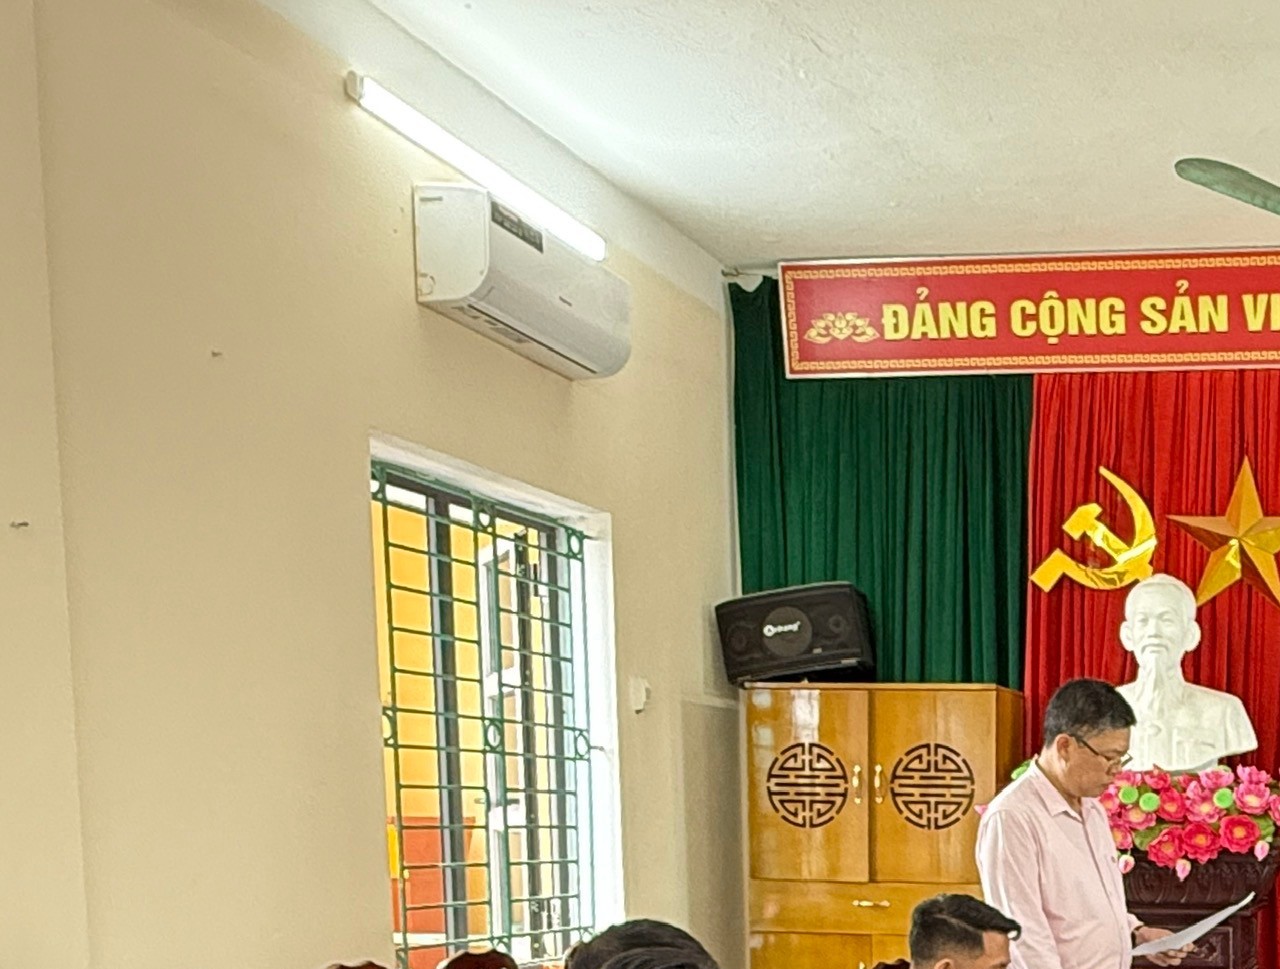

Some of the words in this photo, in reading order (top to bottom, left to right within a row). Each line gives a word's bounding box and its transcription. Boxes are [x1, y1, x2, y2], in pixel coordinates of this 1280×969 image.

[879, 287, 996, 341] ĐẢNG
[1010, 290, 1125, 344] CỘNG
[1140, 280, 1228, 335] SẢN
